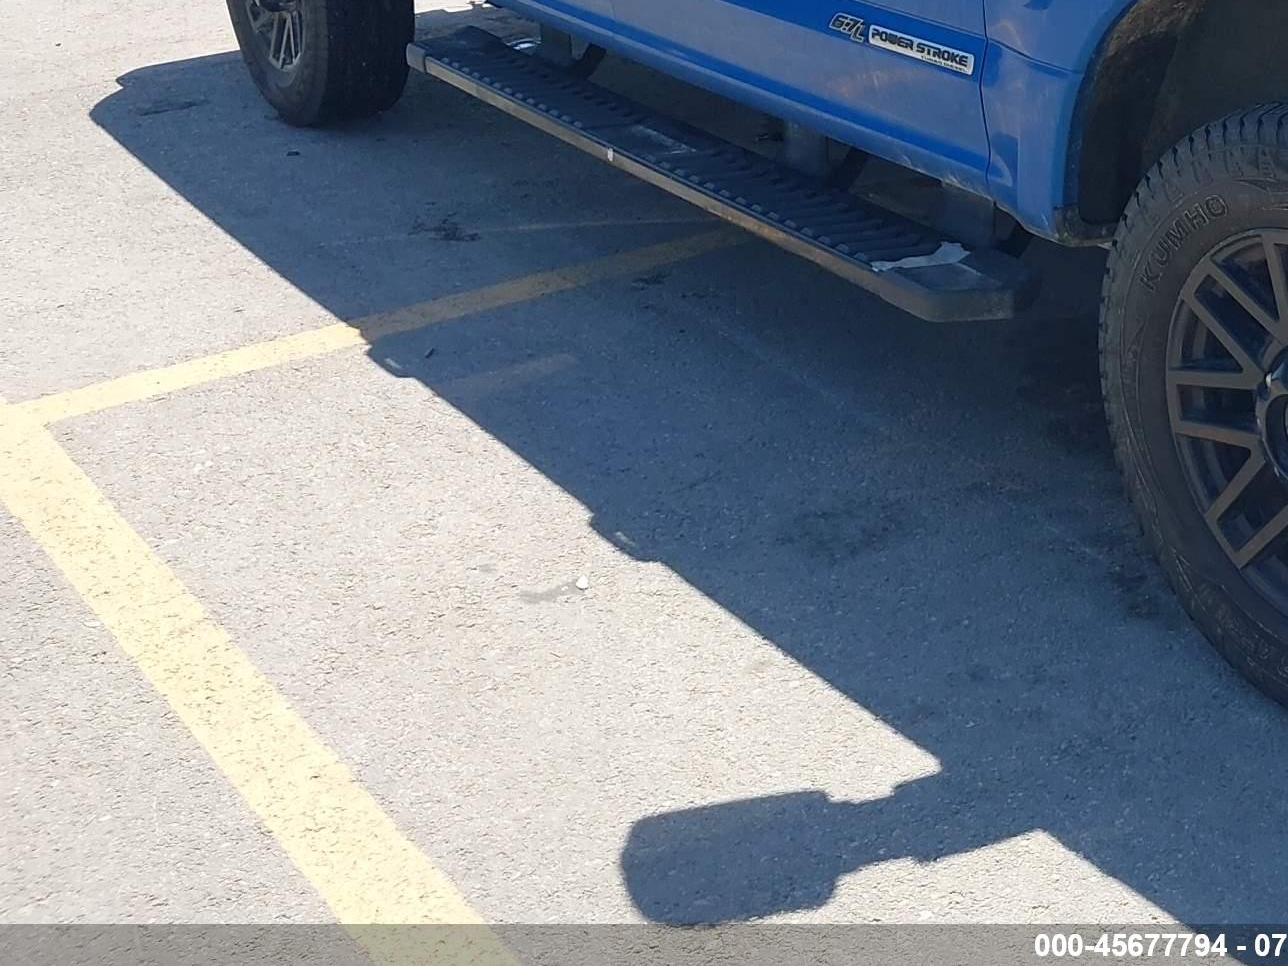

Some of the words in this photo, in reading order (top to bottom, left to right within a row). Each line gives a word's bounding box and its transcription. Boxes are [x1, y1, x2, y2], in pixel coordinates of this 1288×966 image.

[830, 12, 866, 43] 6.7L
[871, 27, 914, 52] POWER
[916, 42, 969, 68] STROKE
[1136, 194, 1229, 292] KUMHO
